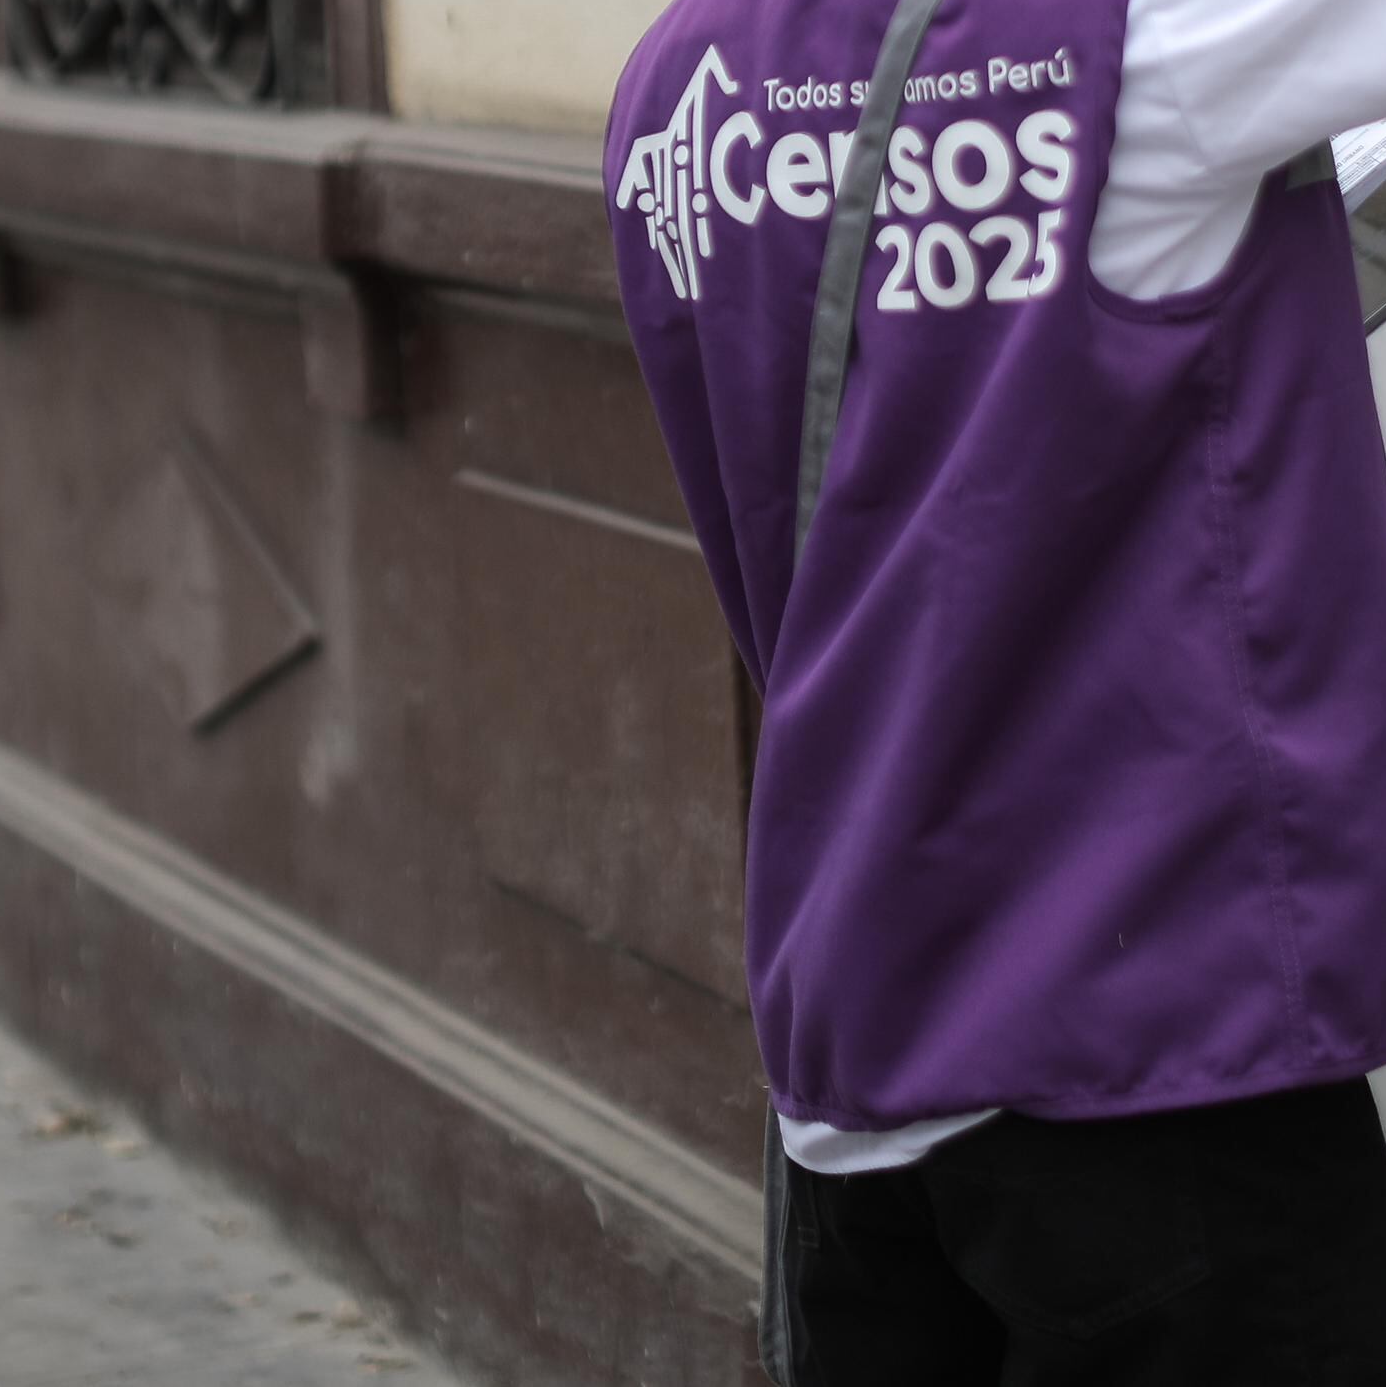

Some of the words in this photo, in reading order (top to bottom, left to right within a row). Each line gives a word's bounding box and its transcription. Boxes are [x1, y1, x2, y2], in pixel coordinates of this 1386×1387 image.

[763, 77, 842, 111] Todos
[850, 70, 977, 106] samos
[987, 47, 1072, 95] Perú
[874, 208, 1062, 311] 2025
